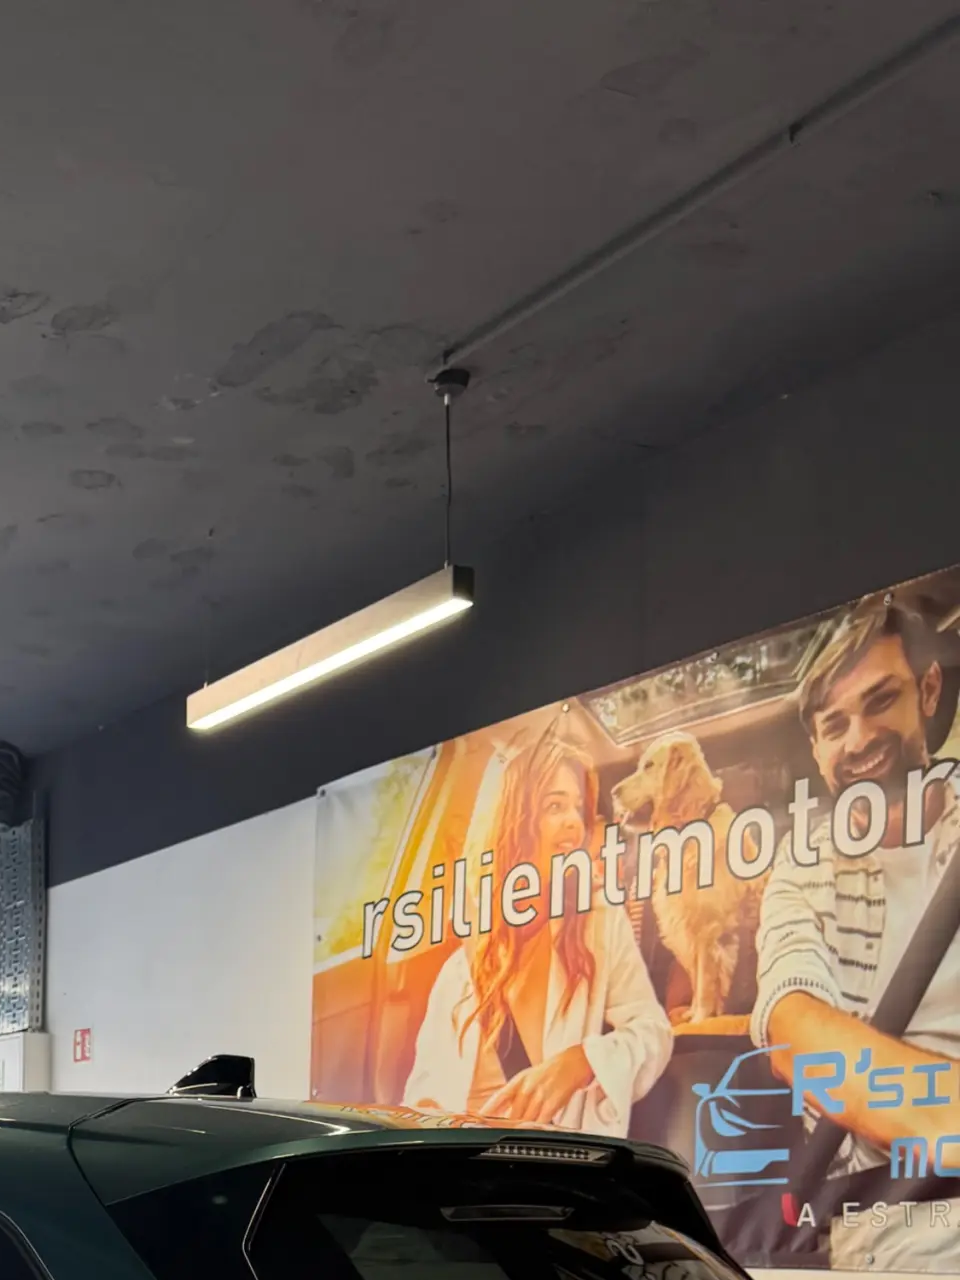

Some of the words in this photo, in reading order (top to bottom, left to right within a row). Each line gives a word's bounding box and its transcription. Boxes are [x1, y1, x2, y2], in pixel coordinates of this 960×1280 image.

[362, 757, 960, 959] rsilientmotor
[792, 1047, 960, 1117] R'SI
[797, 1202, 816, 1228] A
[842, 1200, 960, 1229] ESTR
